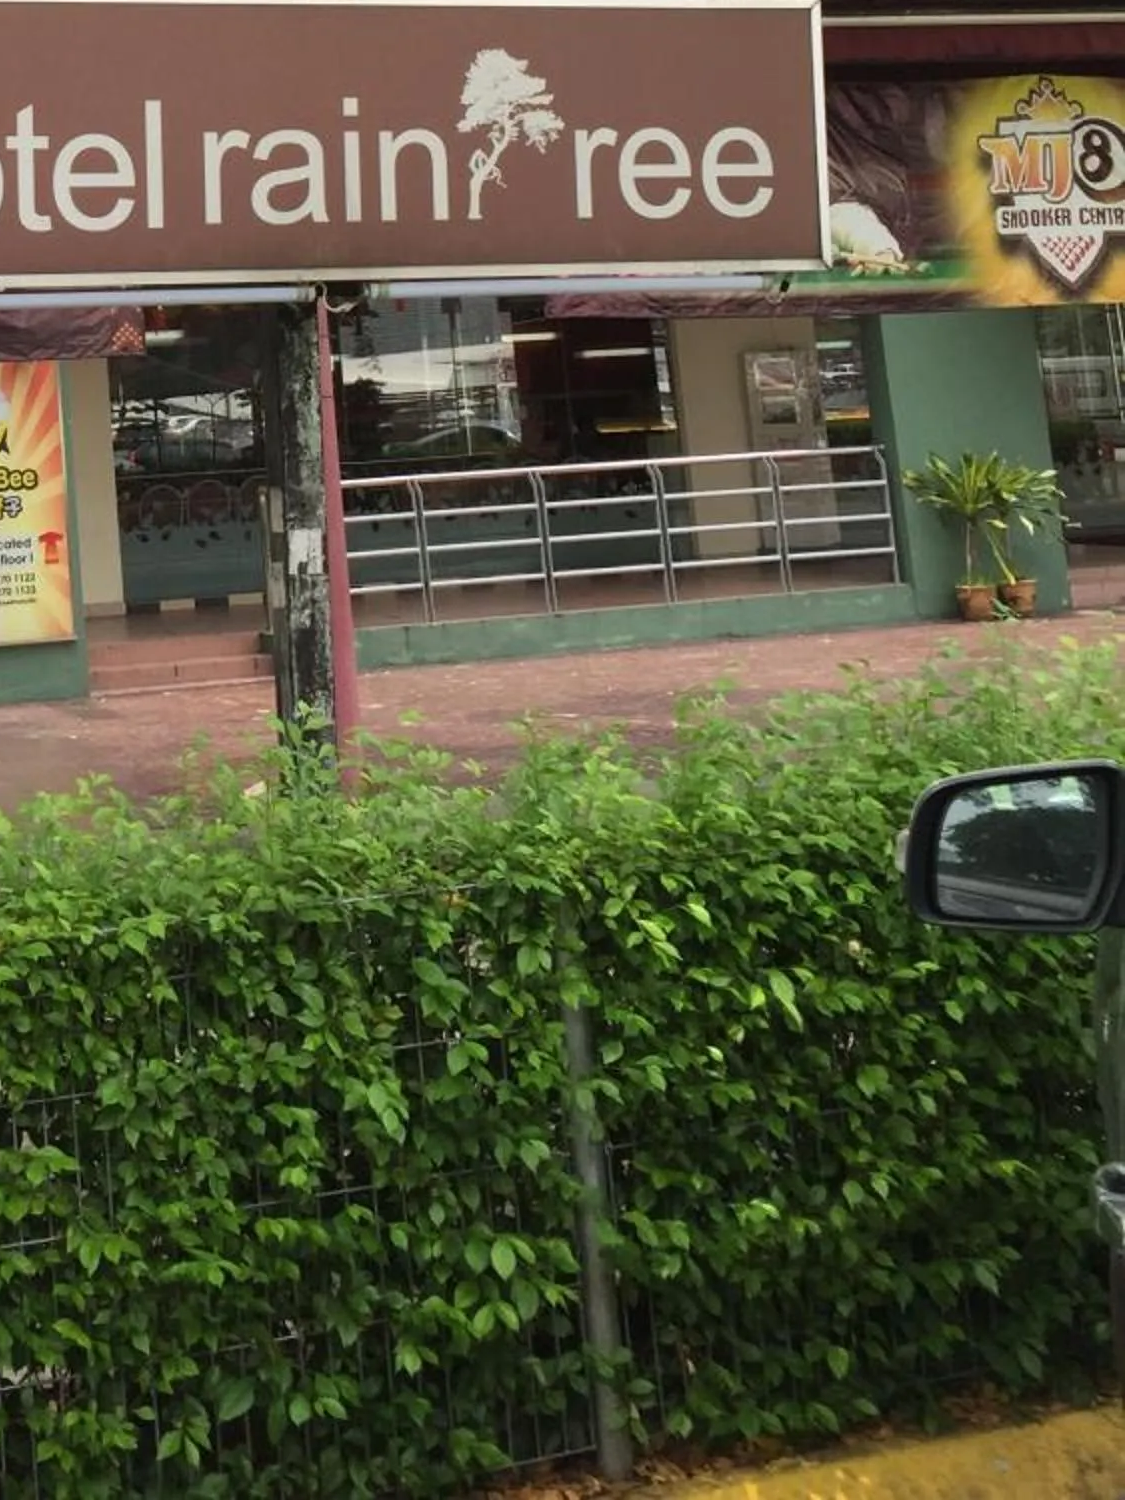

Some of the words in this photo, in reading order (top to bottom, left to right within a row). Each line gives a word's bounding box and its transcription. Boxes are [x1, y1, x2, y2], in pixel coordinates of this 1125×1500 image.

[1001, 207, 1072, 229] SNOOKER
[1079, 206, 1125, 227] CENTR
[0, 553, 27, 566] floor
